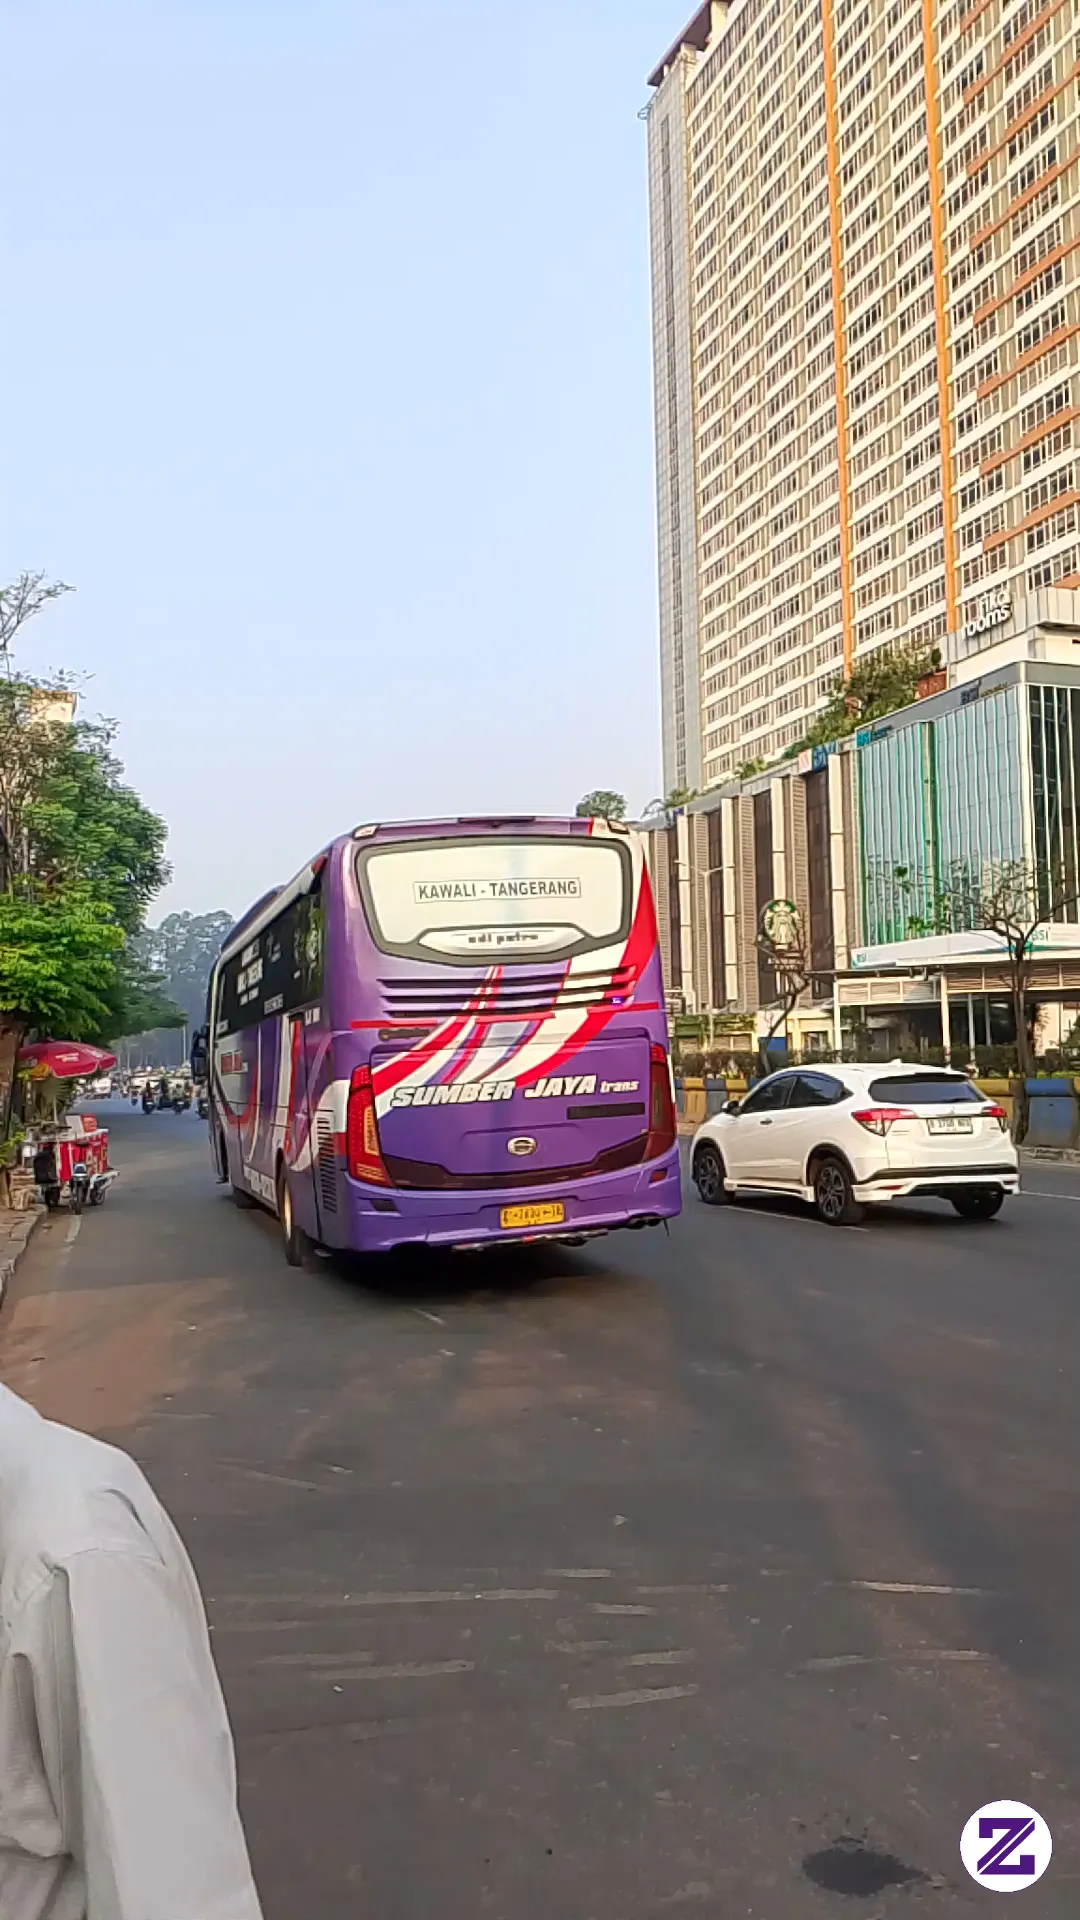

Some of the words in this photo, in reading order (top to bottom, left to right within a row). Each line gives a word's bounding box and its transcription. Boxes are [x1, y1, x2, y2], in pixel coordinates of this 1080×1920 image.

[961, 604, 1010, 640] rooms
[418, 882, 477, 899] KAWALI
[489, 880, 578, 897] TANGERANG
[390, 1080, 517, 1108] SUMBER
[524, 1075, 597, 1099] JAYA
[600, 1080, 639, 1094] trans
